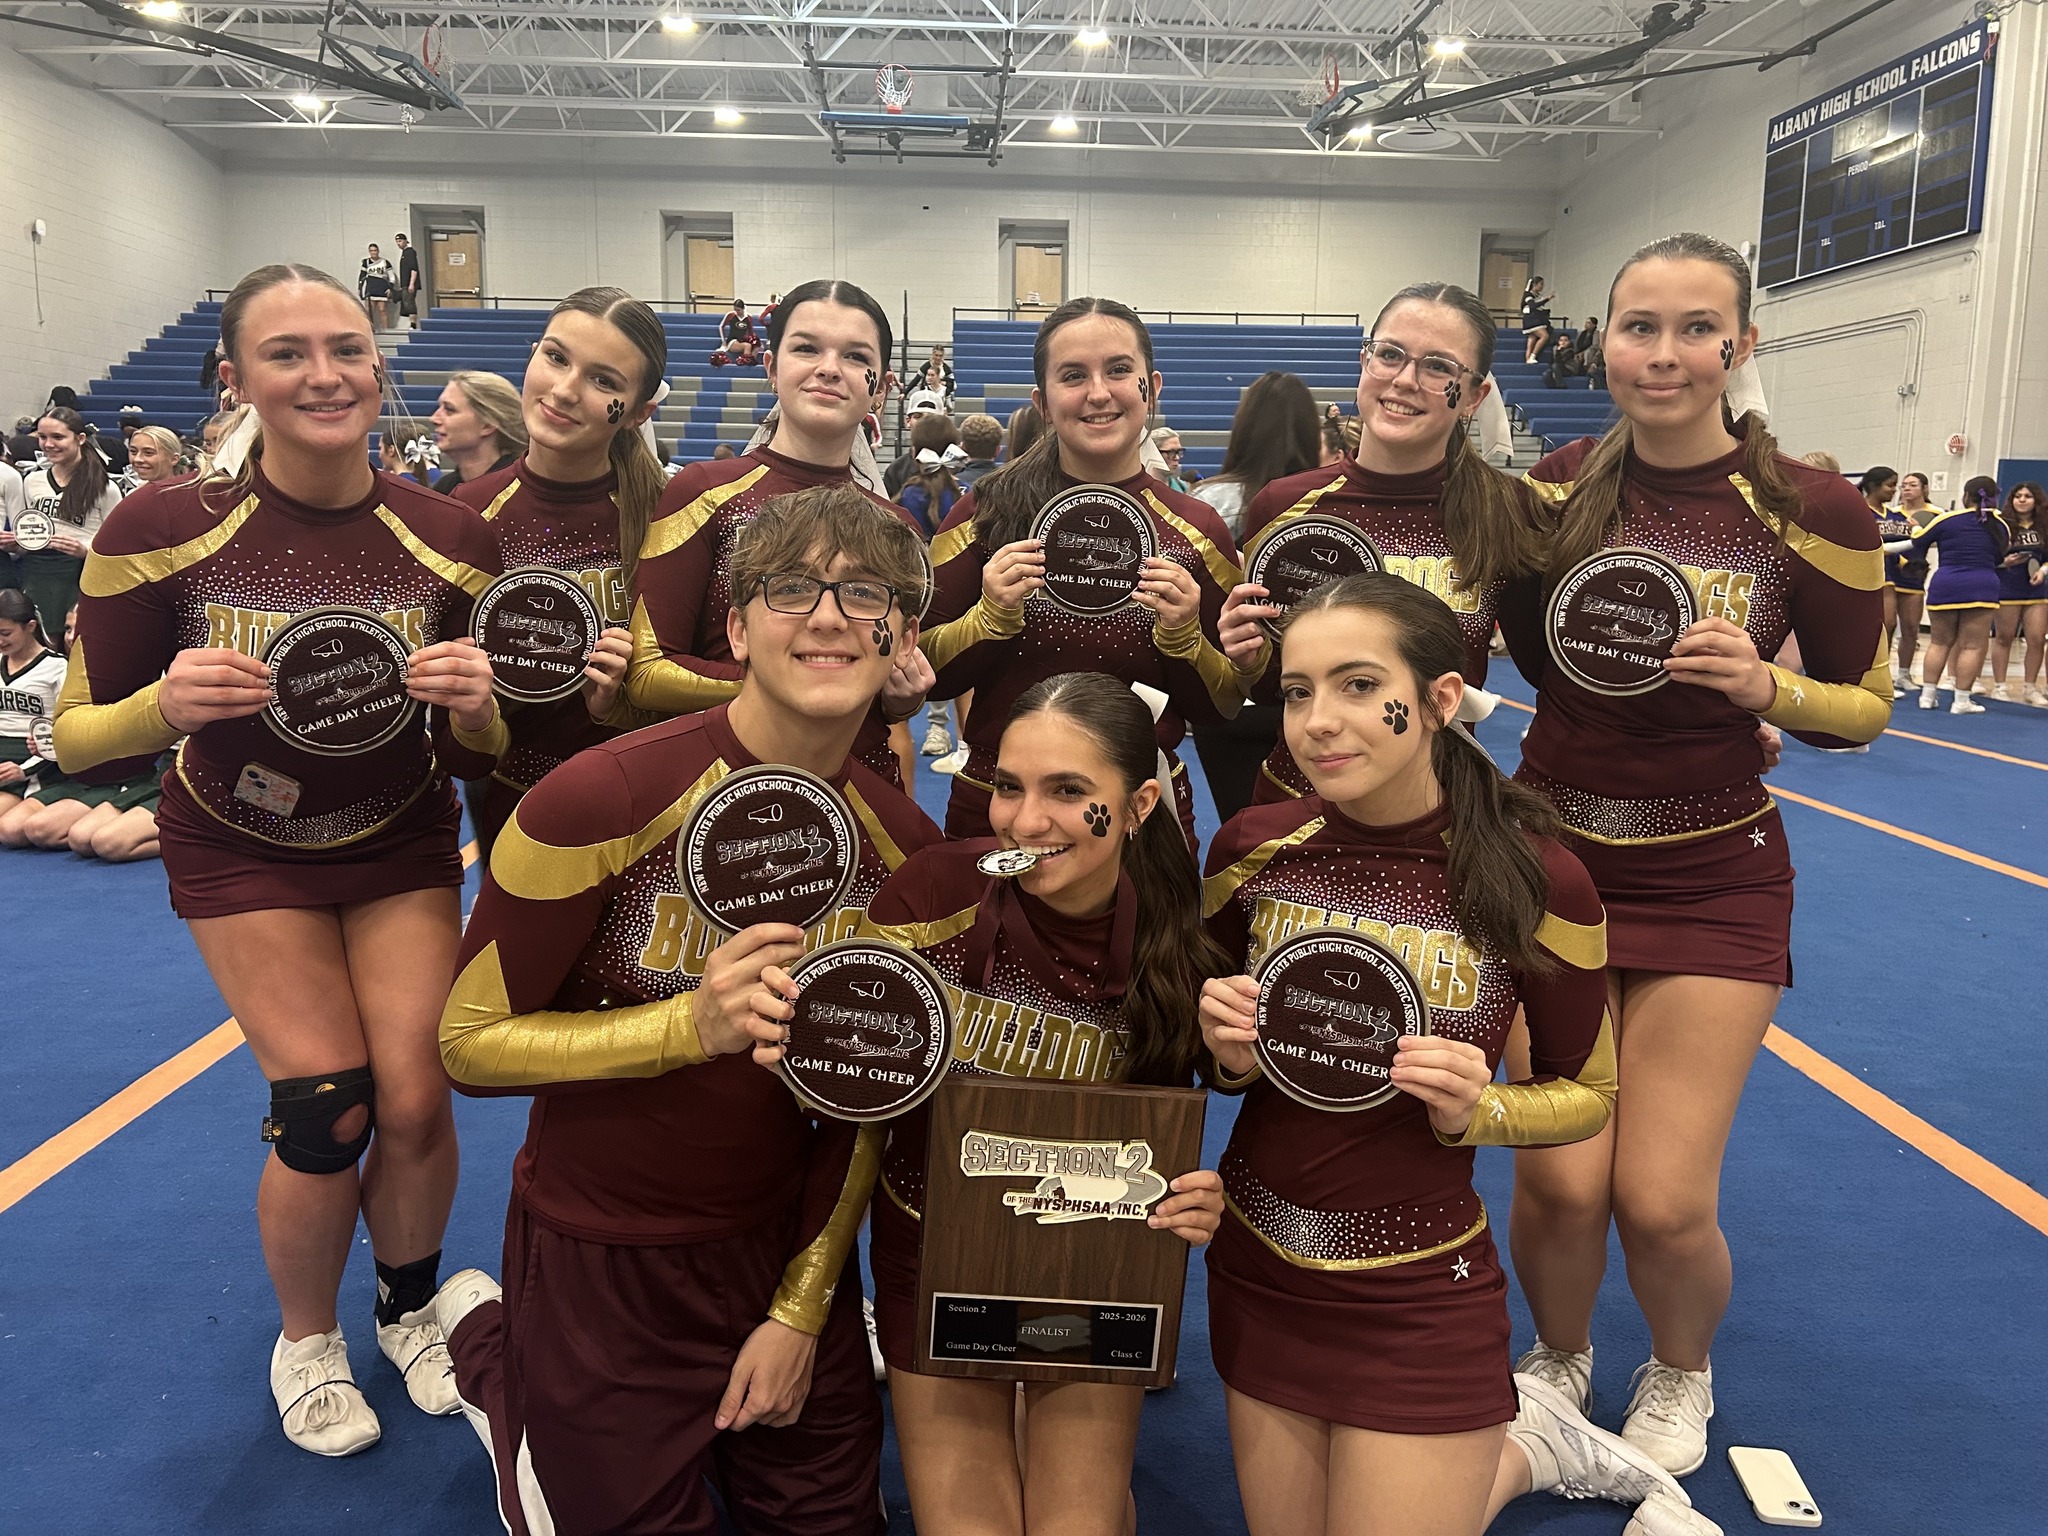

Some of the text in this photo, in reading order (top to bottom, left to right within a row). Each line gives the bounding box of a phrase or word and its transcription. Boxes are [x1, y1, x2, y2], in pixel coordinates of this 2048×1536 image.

[1770, 30, 1981, 144] ALBANY HIGH SCHOOL FALCONS
[1847, 160, 1869, 177] PERIOD
[1044, 511, 1060, 529] STATE
[1056, 498, 1080, 515] PUBLIC
[1079, 495, 1096, 504] HIGH
[1096, 495, 1121, 510] SCHOOL
[1120, 506, 1145, 534] ATHLETIC
[1057, 529, 1132, 556] SECTION 2
[1256, 526, 1375, 585] EW YORK STATE PUBLIC HIGH SCHOOL ATHLETI
[1615, 559, 1635, 568] HIGH
[523, 576, 541, 585] HIGH
[1046, 571, 1132, 589] GAME DAY CHEER
[1588, 560, 1615, 577] PUBLIC
[1635, 560, 1664, 578] SCHOOL
[499, 579, 524, 595] PUBLIC
[541, 577, 567, 593] SCHOOL
[1570, 571, 1591, 592] STATE
[1661, 575, 1686, 607] ATHLETIC
[485, 590, 503, 610] STATE
[566, 589, 591, 618] ATHLETIC
[1561, 590, 1575, 610] YORK
[1581, 592, 1655, 626] SECTION
[1656, 609, 1669, 630] 2
[314, 619, 349, 631] SCHOOL
[479, 608, 490, 627] YORK
[497, 609, 577, 640] SECTION 2
[1557, 611, 1567, 627] NEW
[295, 623, 316, 640] HIGH
[349, 621, 387, 642] ATHLETIC
[478, 628, 486, 644] NEW
[581, 618, 595, 661] ASSOCIATION
[276, 635, 298, 661] PUBLIC
[1562, 636, 1662, 669] GAME DAY CHEER
[287, 656, 369, 697] SECTION
[366, 650, 383, 671] 2
[486, 651, 576, 674] GAME DAY CHEER
[0, 688, 44, 717] RES
[274, 704, 290, 722] NEW
[297, 716, 334, 735] GAME
[336, 708, 360, 724] DAY
[362, 693, 403, 714] CHEER
[692, 780, 847, 894] NEW YORK STATE PUBLIC HIGH SCHOOL ATHLETIC ASSOCIATION
[715, 823, 822, 865] SECTION 2
[714, 878, 834, 912] GAME DAY CHEER
[1258, 942, 1416, 1036] NEW YORK STATE PUBLIC HIGH SCHOOL ATHLETIC ASSOCI
[799, 953, 941, 1068] ATE PUBLIC HIGH SCHOOL ATHLETIC ASSOCIATION
[808, 1000, 899, 1034] SECTION
[901, 1013, 916, 1039] 2
[1284, 984, 1391, 1032] SECTION 2
[946, 981, 1132, 1082] ULLDOG
[791, 1055, 915, 1086] GAME DAY CHEER
[1267, 1038, 1389, 1080] GAME DAY CHEER
[964, 1134, 1148, 1184] SECTION 2
[1018, 1196, 1033, 1204] THE
[1032, 1198, 1115, 1215] NYSPHSAA,
[1117, 1203, 1144, 1217] INC.
[948, 1303, 987, 1314] Section 2
[1099, 1312, 1147, 1322] 2025-2026
[1021, 1326, 1071, 1337] FINALIST
[946, 1341, 1017, 1353] Game Day Cheer
[1110, 1350, 1143, 1359] Class C
